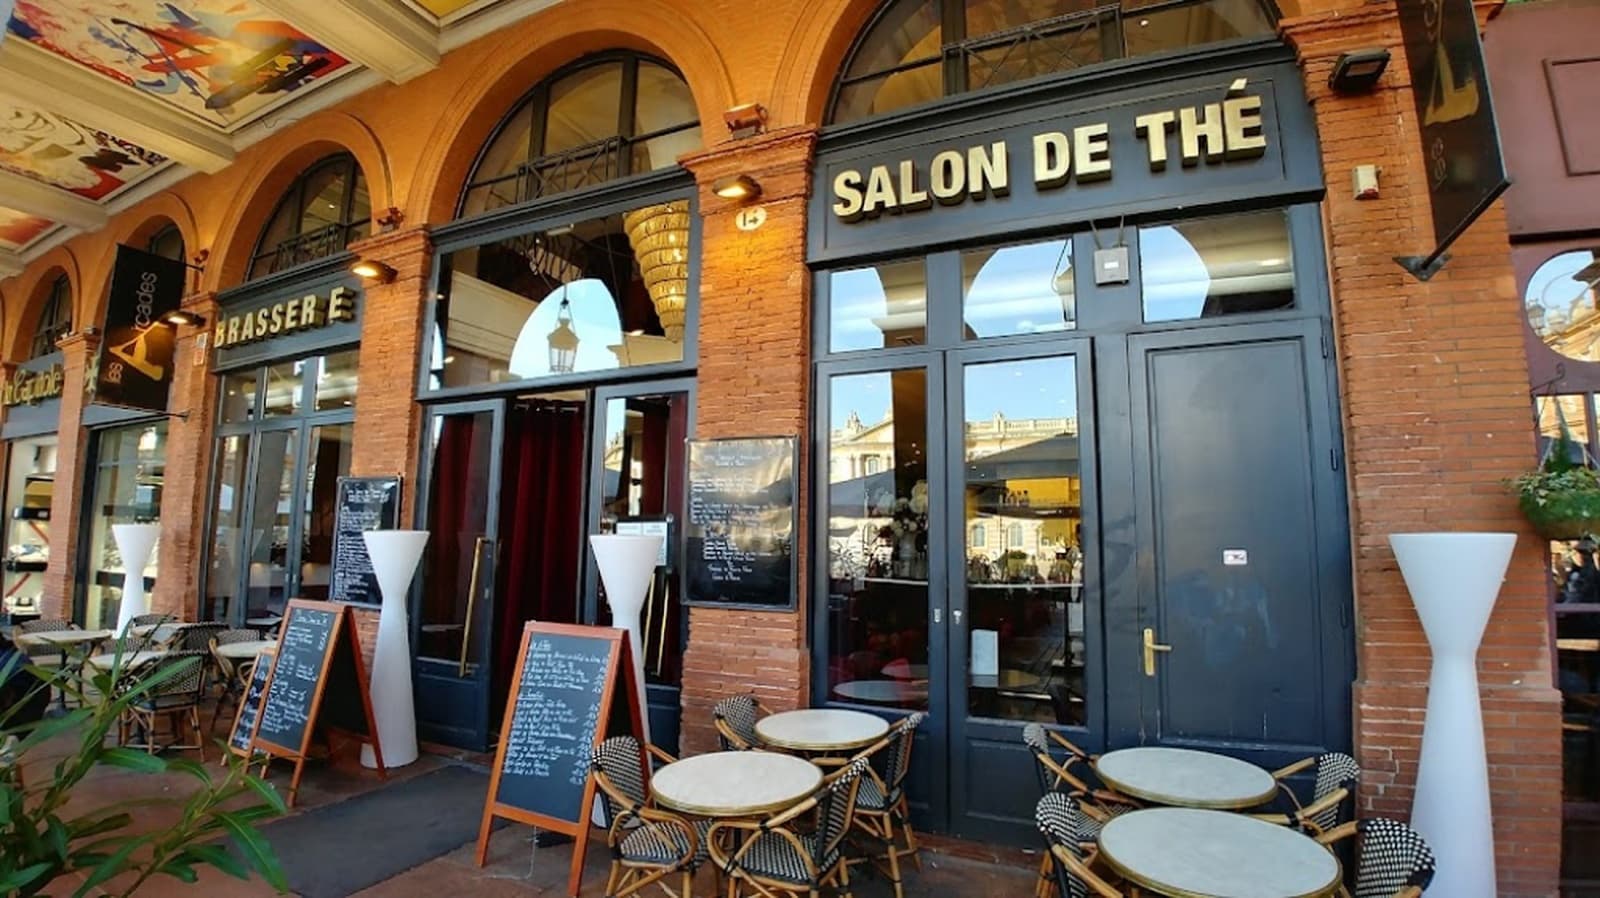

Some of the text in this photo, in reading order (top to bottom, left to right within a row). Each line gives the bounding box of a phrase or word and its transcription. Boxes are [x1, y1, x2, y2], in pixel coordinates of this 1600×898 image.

[832, 78, 1267, 220] SALON DE THÉ
[104, 362, 124, 385] les
